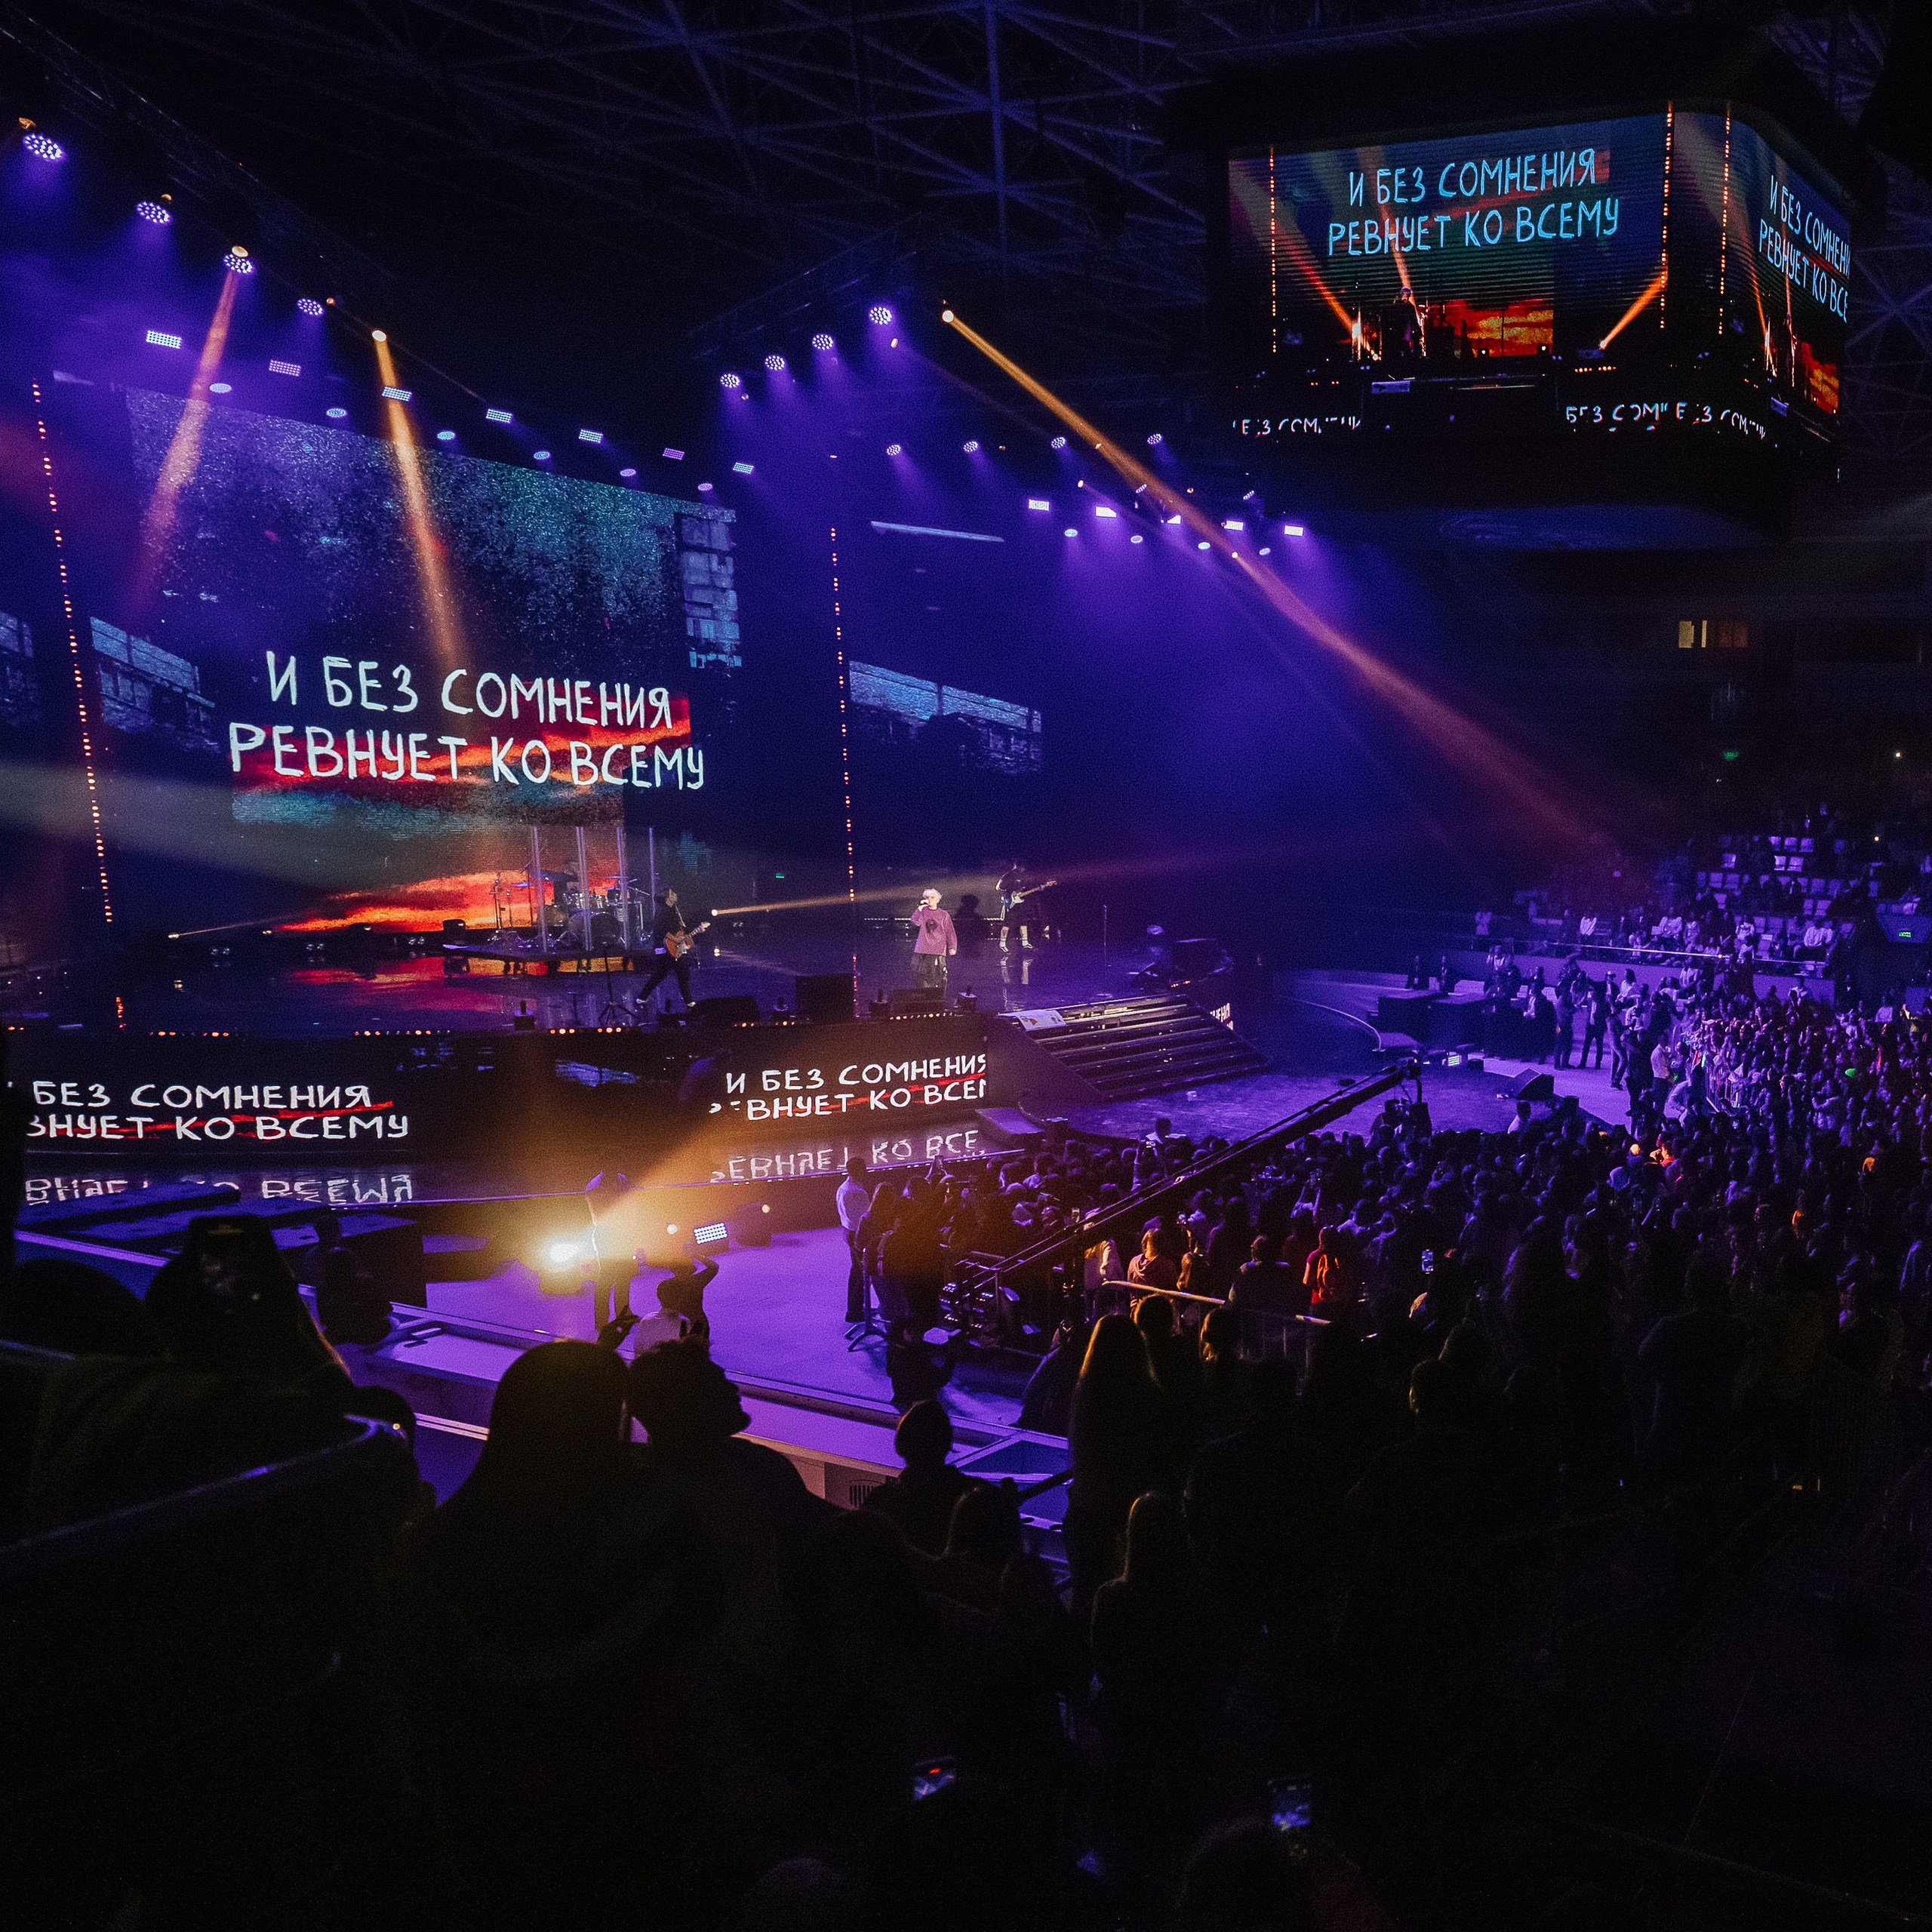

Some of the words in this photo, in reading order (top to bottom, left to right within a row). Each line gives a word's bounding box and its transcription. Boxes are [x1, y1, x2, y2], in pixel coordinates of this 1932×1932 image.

[1349, 171, 1364, 207] И
[1377, 166, 1426, 205] БЕЗ
[1438, 148, 1595, 197] СОМНЕНИЯ
[1770, 175, 1778, 214] И
[1781, 186, 1801, 235] БЕЗ
[1328, 215, 1451, 256] РЕВНУЕТ
[1465, 209, 1503, 247] КО
[1516, 197, 1619, 242] ВСЕМУ
[1759, 219, 1809, 288] РЕВНУЕТ
[1813, 263, 1827, 303] КО
[267, 651, 297, 705] И
[322, 656, 419, 712] БЕЗ
[442, 668, 672, 729] СОМНЕНИЯ
[229, 721, 469, 780] РЕВНУЕТ
[491, 736, 551, 786] КО
[571, 741, 705, 789] ВСЕМУ
[32, 1081, 110, 1107] БЕЗ
[130, 1084, 372, 1109] СОМНЕНИЯ
[726, 1072, 746, 1094] И
[762, 1069, 824, 1091] БЕЗ
[870, 1088, 911, 1110] КО
[175, 1116, 235, 1140] КО
[256, 1115, 409, 1140] ВСЕМУ
